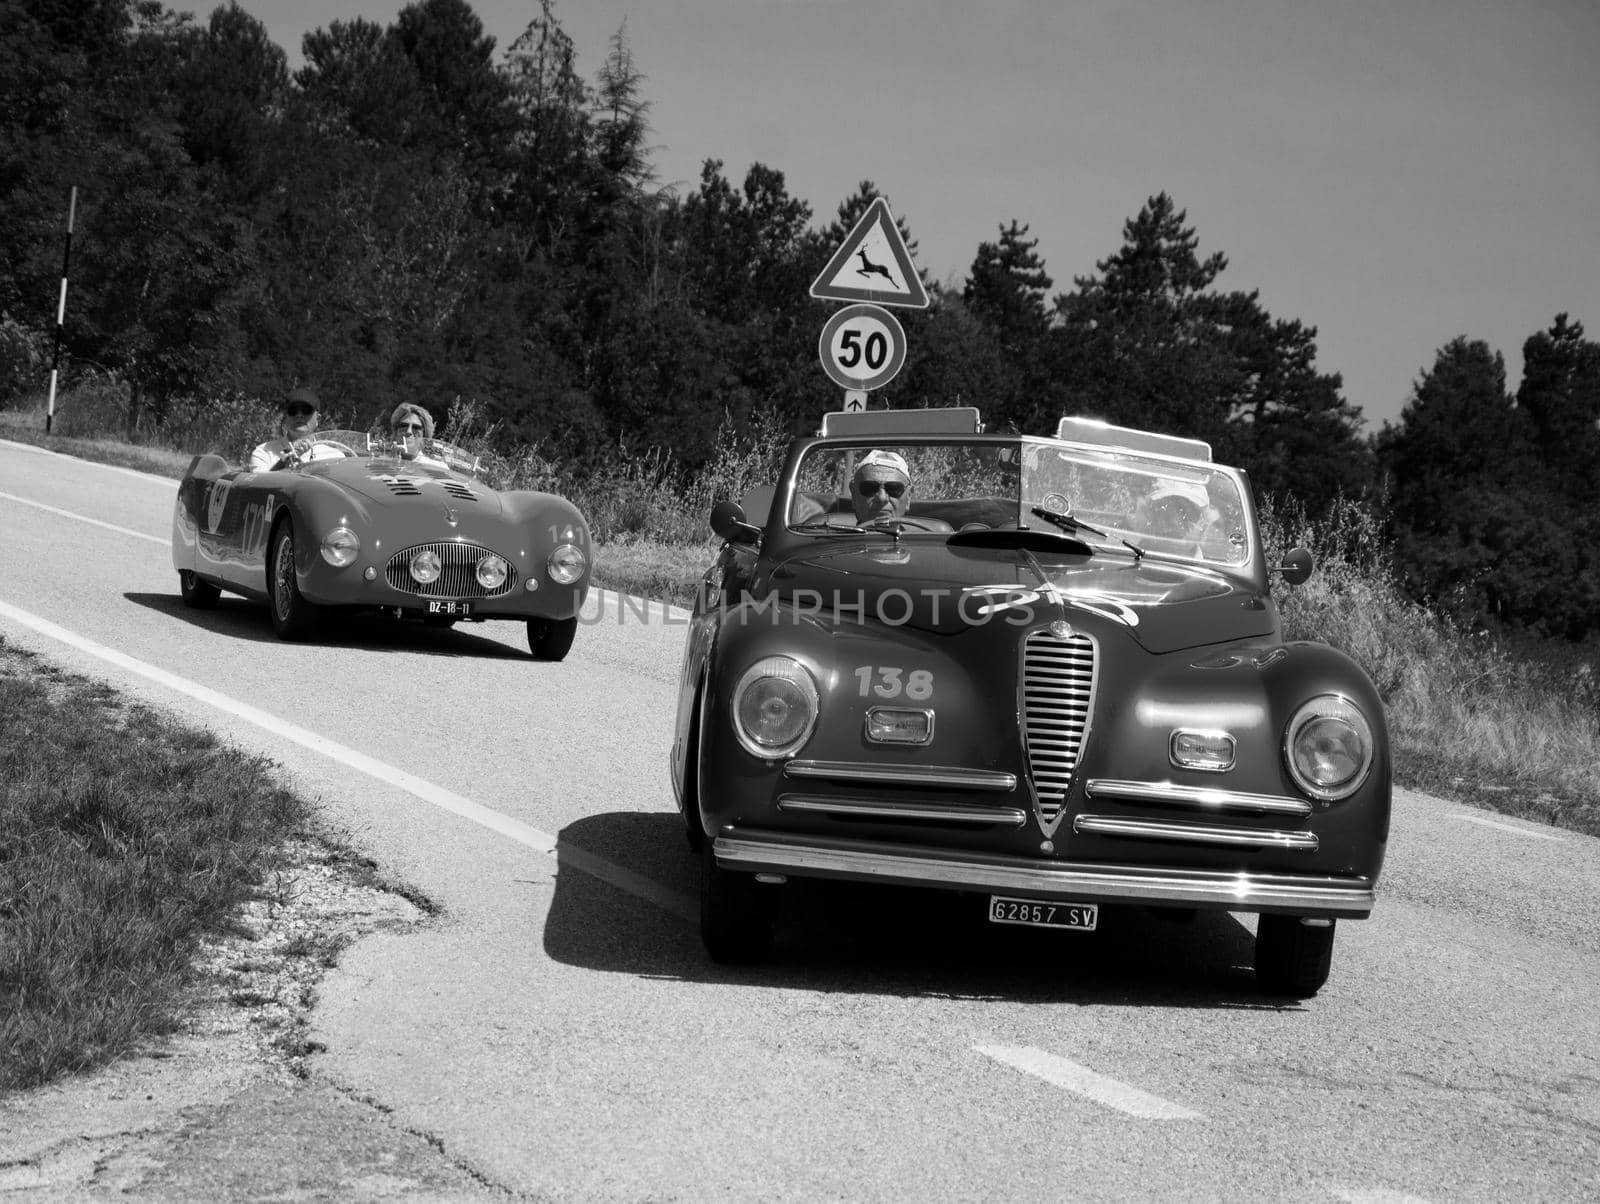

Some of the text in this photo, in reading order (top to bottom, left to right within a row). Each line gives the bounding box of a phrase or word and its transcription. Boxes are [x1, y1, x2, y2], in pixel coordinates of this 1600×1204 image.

[837, 329, 888, 370] 50
[548, 524, 584, 545] 141
[429, 601, 470, 615] DZ-18-11
[853, 665, 935, 701] 138
[995, 903, 1092, 926] 62857 SV
